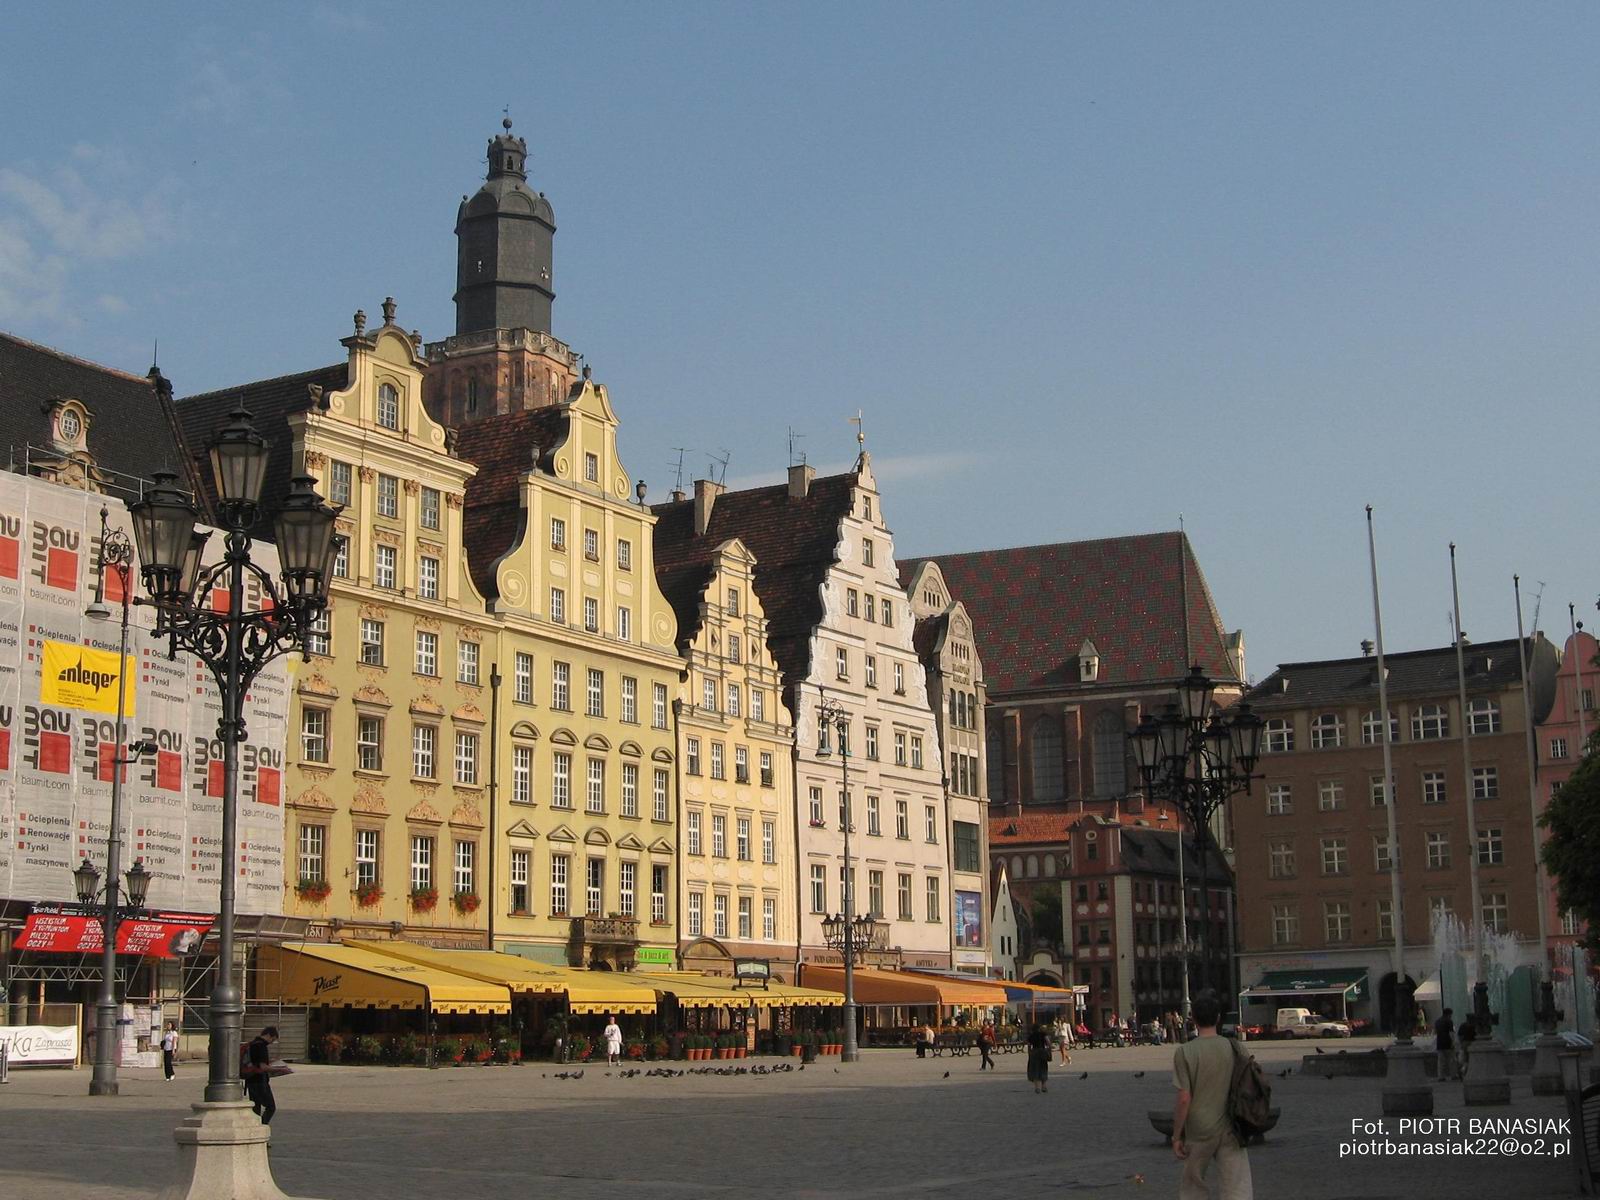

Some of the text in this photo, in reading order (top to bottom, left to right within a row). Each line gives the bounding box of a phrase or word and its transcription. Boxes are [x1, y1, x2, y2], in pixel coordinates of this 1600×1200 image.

[151, 663, 186, 678] Renowacje
[151, 677, 170, 687] Tynki
[21, 776, 70, 790] baumit.com
[139, 794, 181, 807] baumit.com
[192, 803, 222, 813] baumit.c
[28, 814, 71, 826] Ocieplenia
[27, 827, 71, 841] Renowacje
[145, 829, 182, 841] Ocieplenia
[27, 842, 49, 852] Tynki
[26, 857, 69, 869] maszynowe
[145, 856, 166, 866] Tynki
[149, 871, 181, 882] aszynowe
[313, 976, 342, 995] Piast
